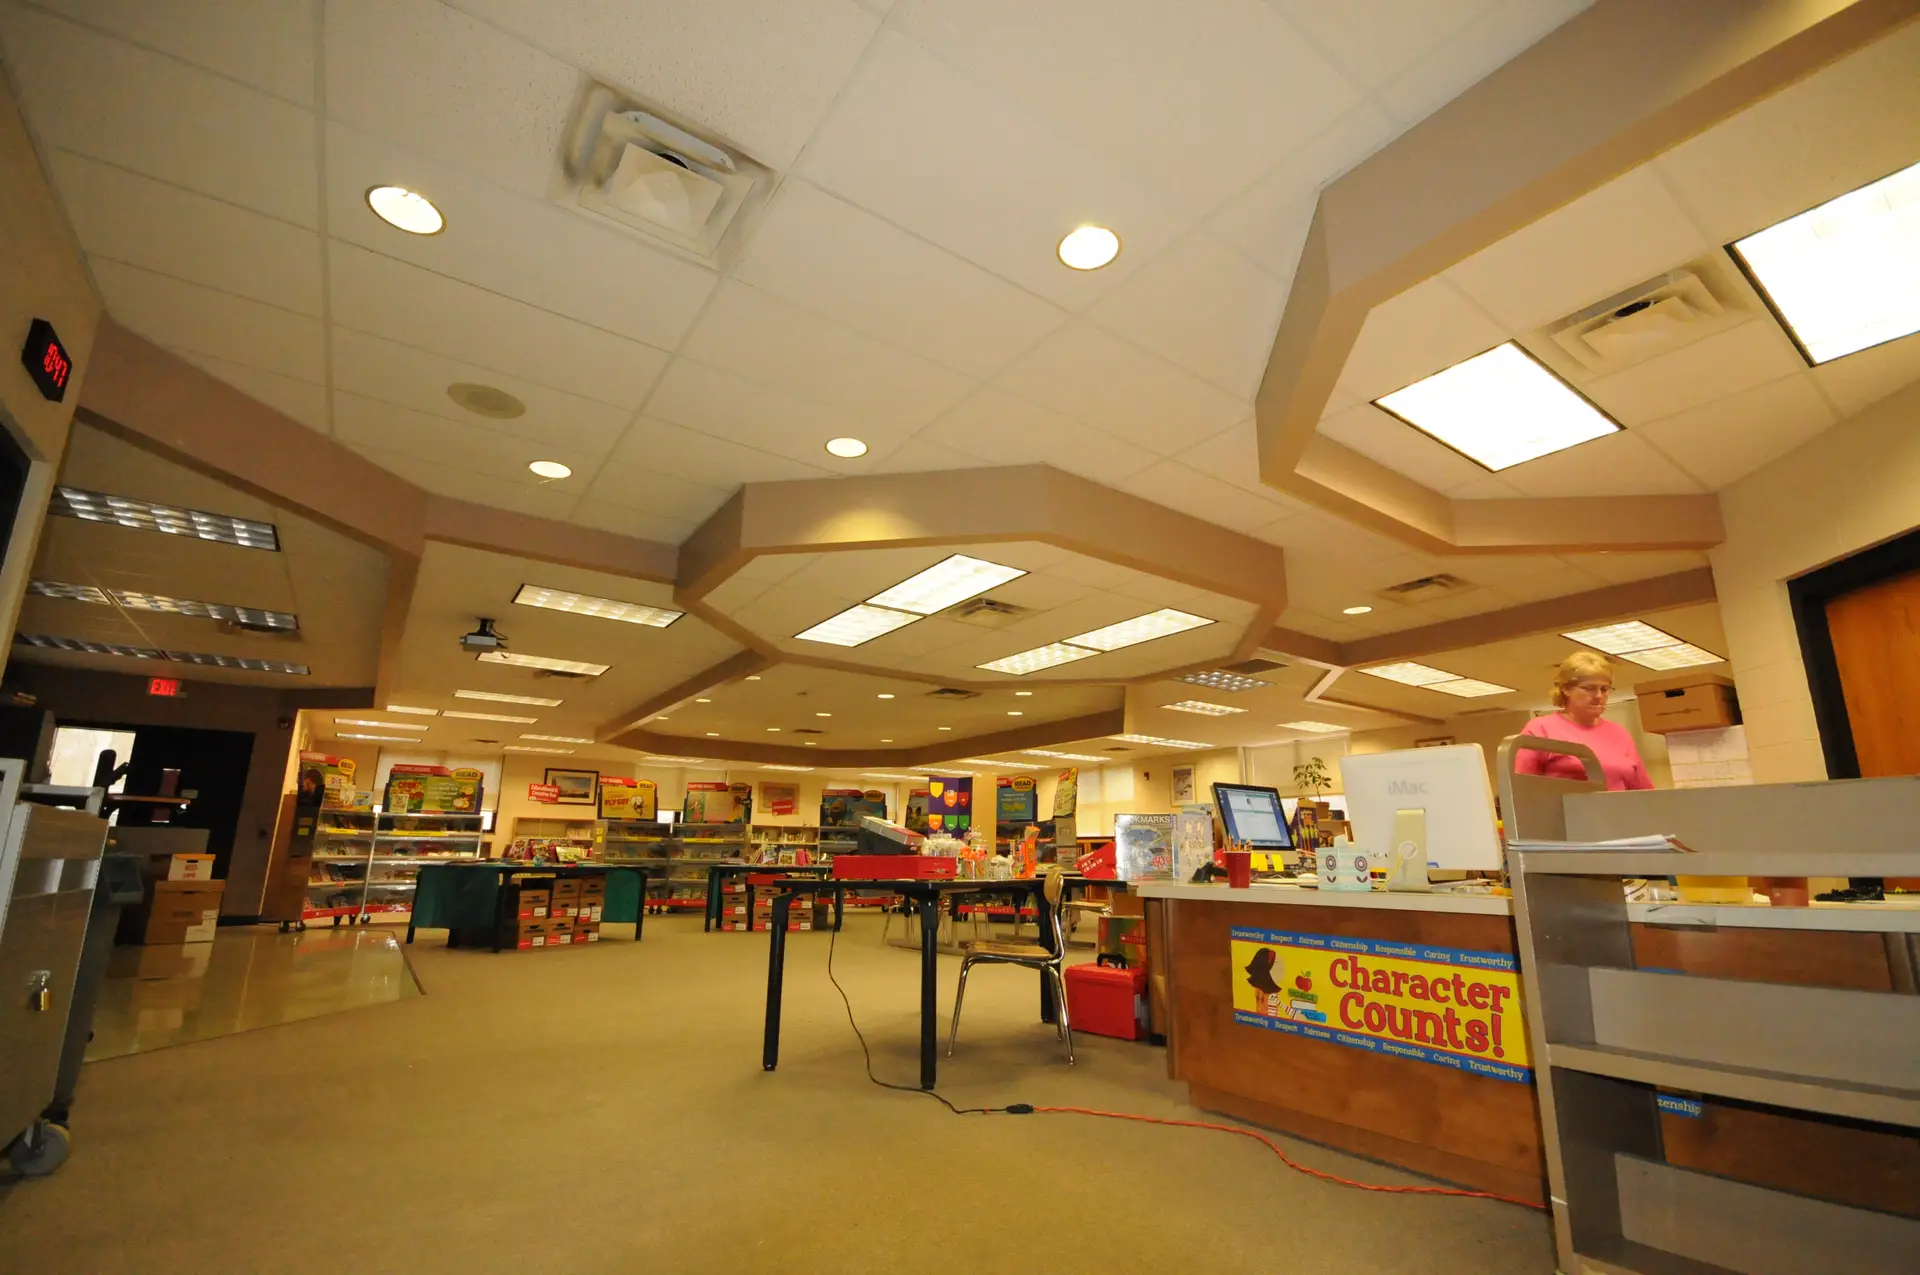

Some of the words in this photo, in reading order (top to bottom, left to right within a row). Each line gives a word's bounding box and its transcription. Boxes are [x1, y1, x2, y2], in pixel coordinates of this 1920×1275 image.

[1388, 780, 1429, 795] iMac
[1330, 940, 1368, 952] Citizenship
[1375, 944, 1416, 957] Responsible
[1424, 950, 1451, 962] Caring
[1459, 954, 1513, 969] Trustworthy
[1329, 955, 1510, 1013] Character
[1339, 992, 1505, 1058] Counts!
[1336, 1033, 1376, 1048] Citizenship
[1383, 1042, 1426, 1058] Responsible
[1433, 1053, 1461, 1067] Caring
[1468, 1060, 1524, 1081] Trustworthy
